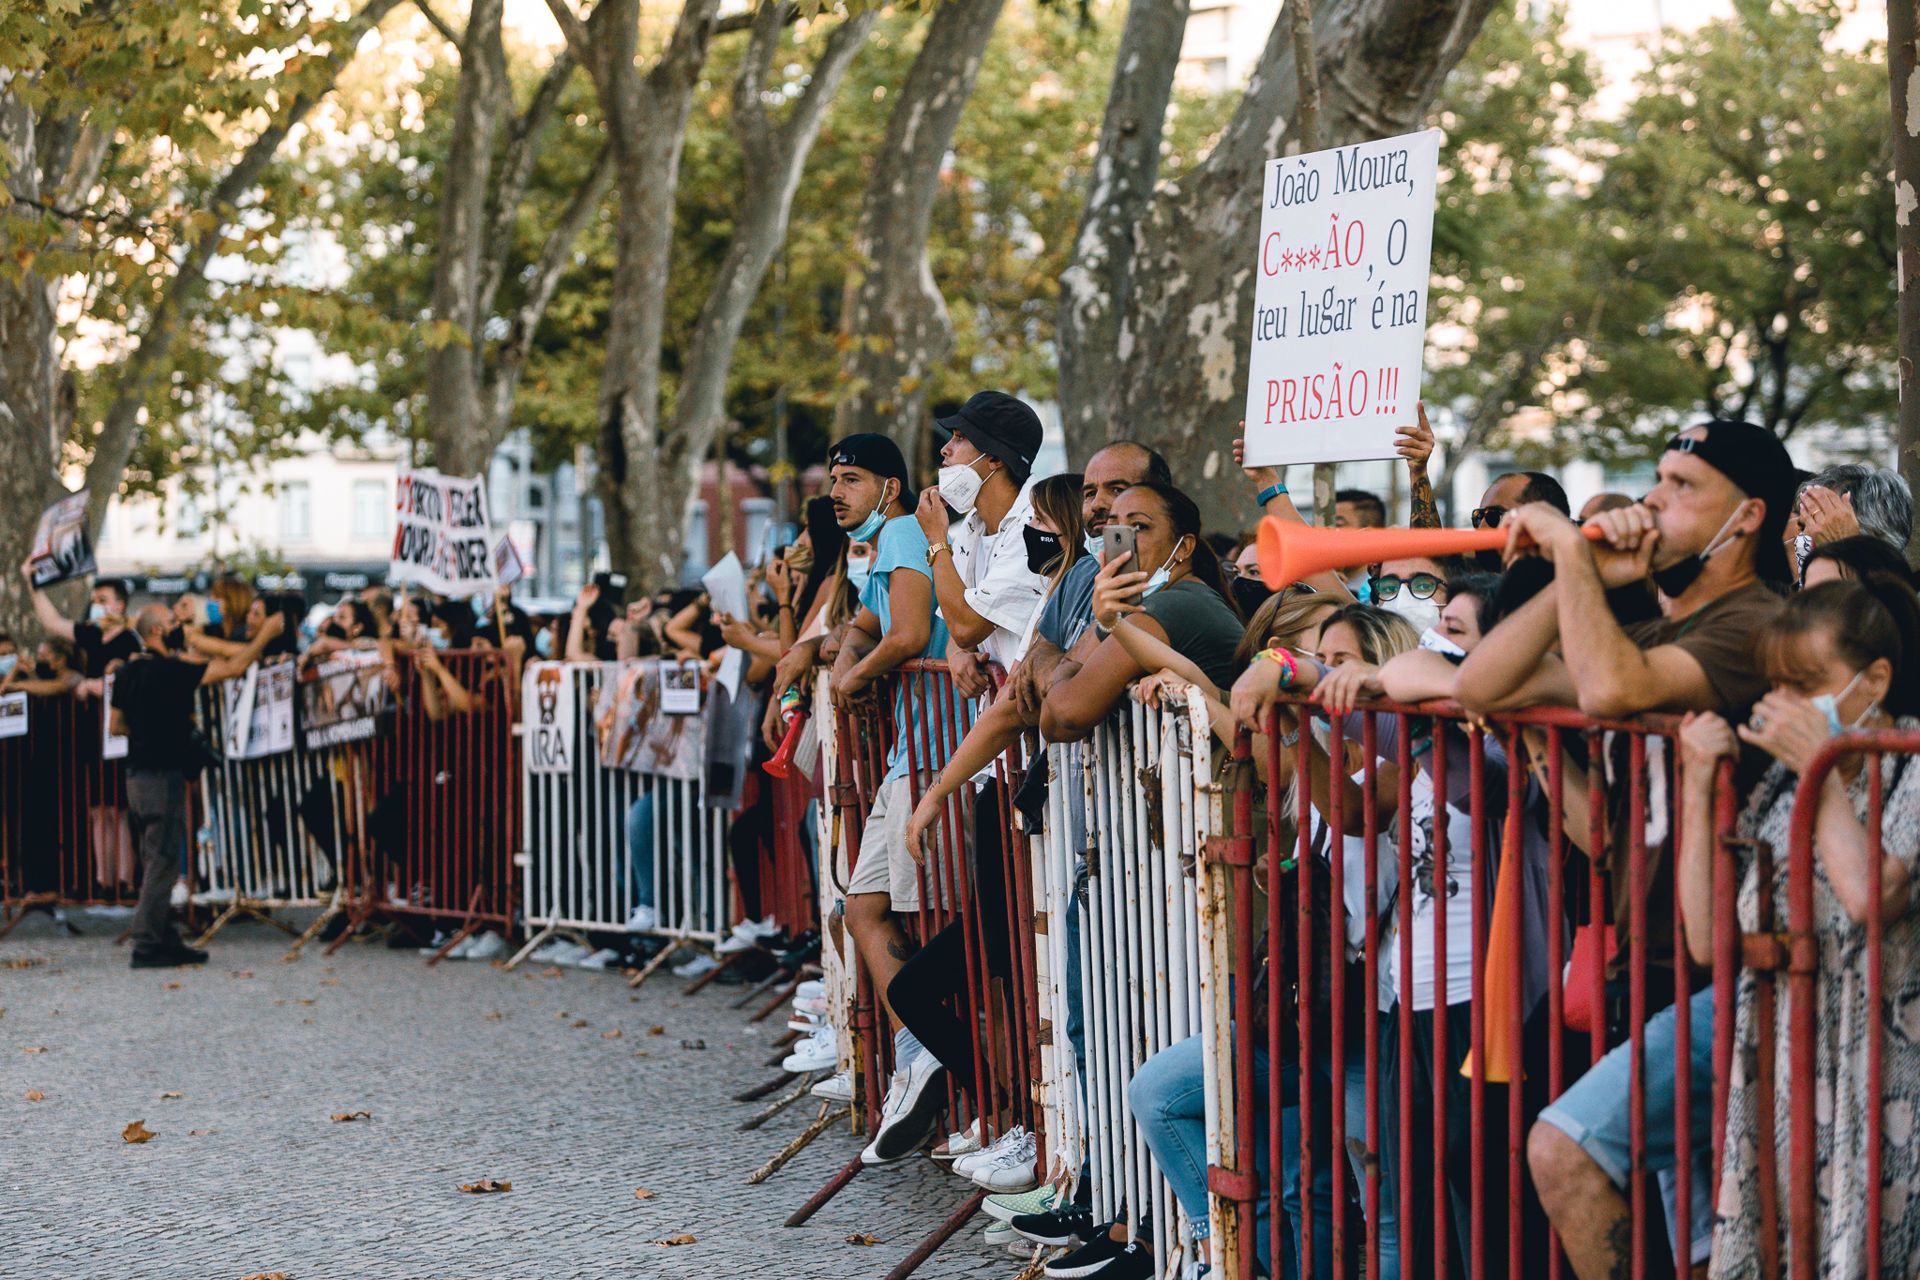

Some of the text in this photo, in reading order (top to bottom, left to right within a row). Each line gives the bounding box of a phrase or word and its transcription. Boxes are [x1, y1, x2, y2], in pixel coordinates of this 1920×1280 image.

[1270, 146, 1414, 209] João Moura,
[1257, 280, 1418, 341] teu lugar é na
[1264, 362, 1369, 424] PRISÃO
[531, 727, 568, 766] IRA
